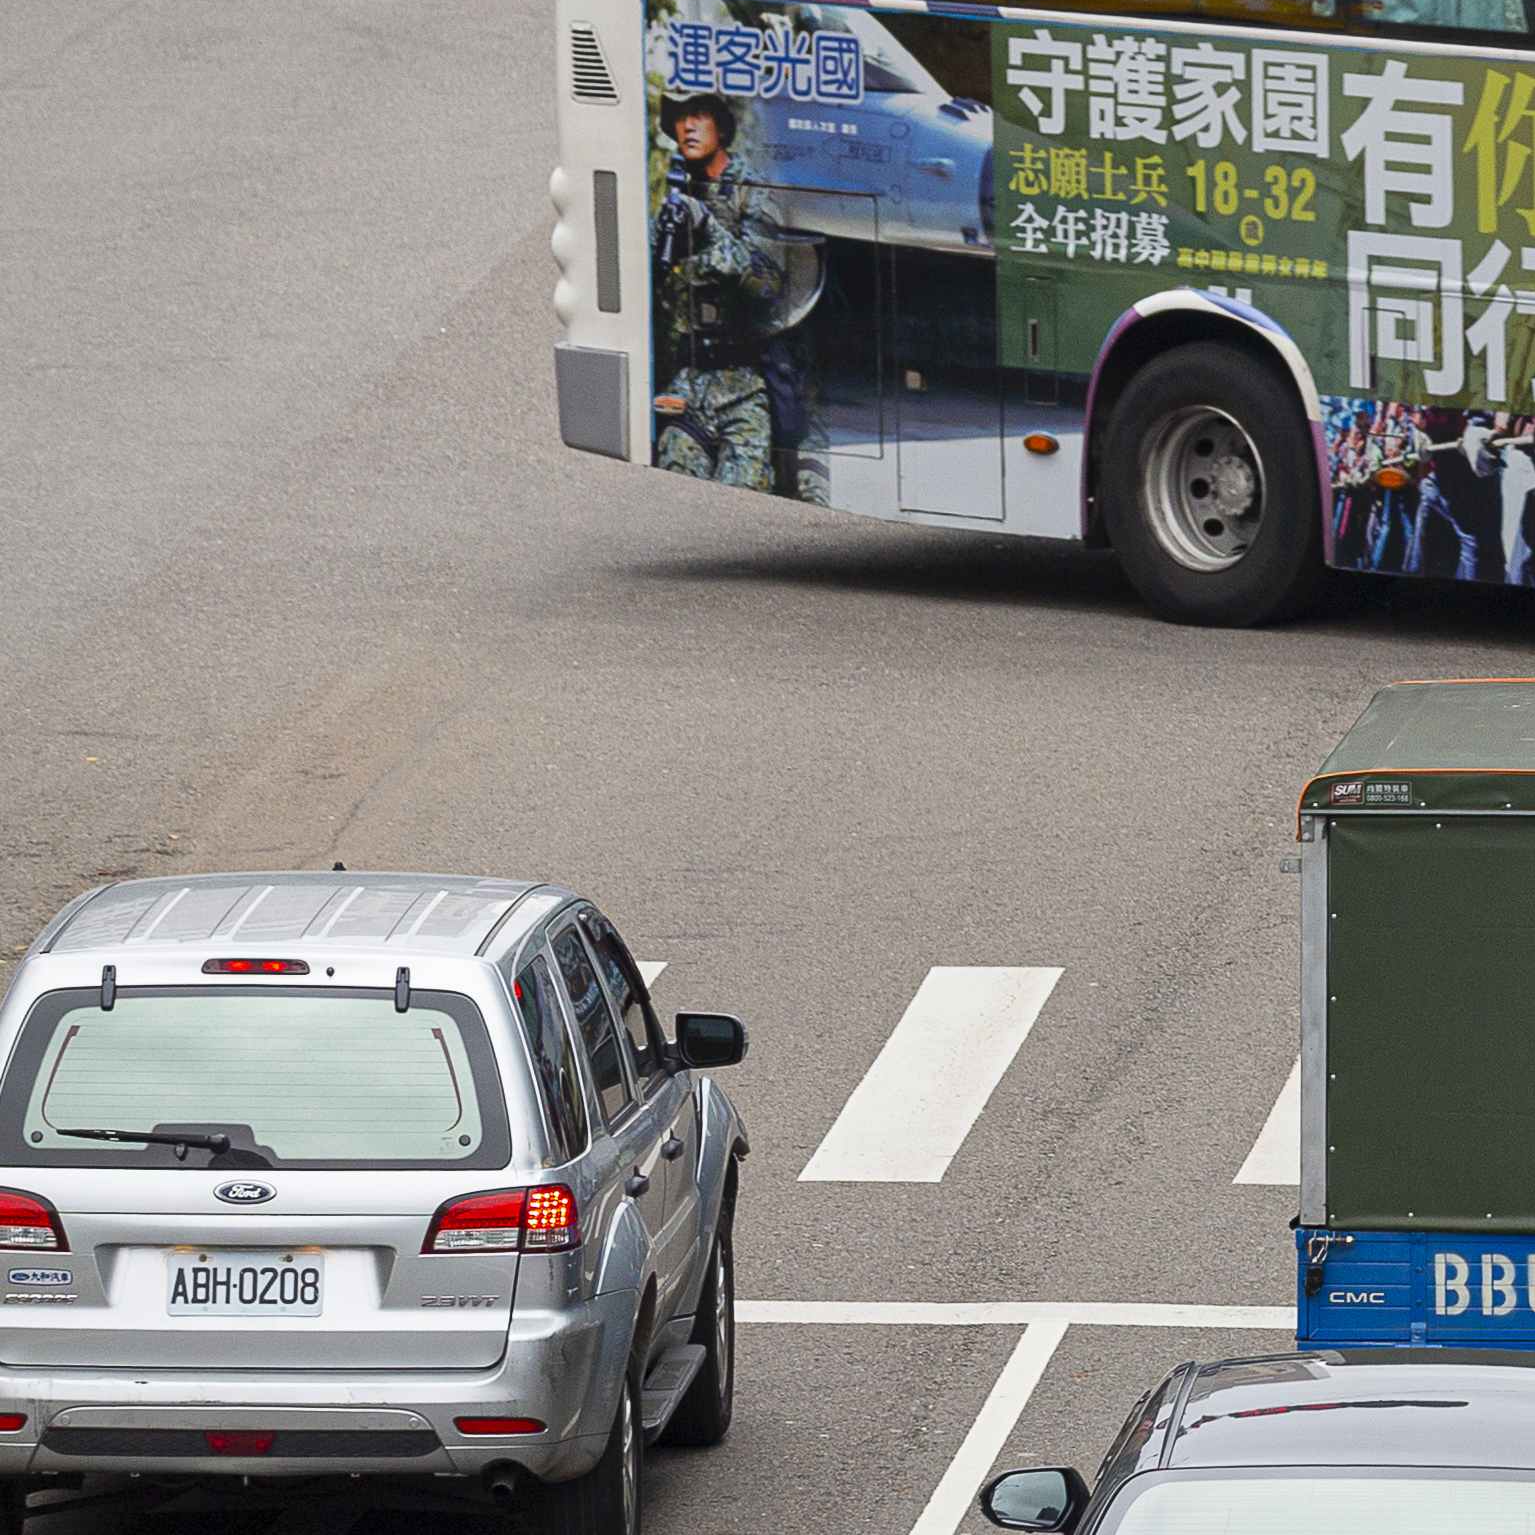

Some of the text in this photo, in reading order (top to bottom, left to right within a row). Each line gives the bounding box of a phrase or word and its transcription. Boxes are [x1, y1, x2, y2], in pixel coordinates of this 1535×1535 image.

[1005, 28, 1331, 160] 守護家園
[1008, 143, 1317, 222] 志願士兵 18-32
[1009, 202, 1172, 267] 全年招募
[228, 1184, 262, 1200] Ford
[1329, 1291, 1386, 1305] CMC
